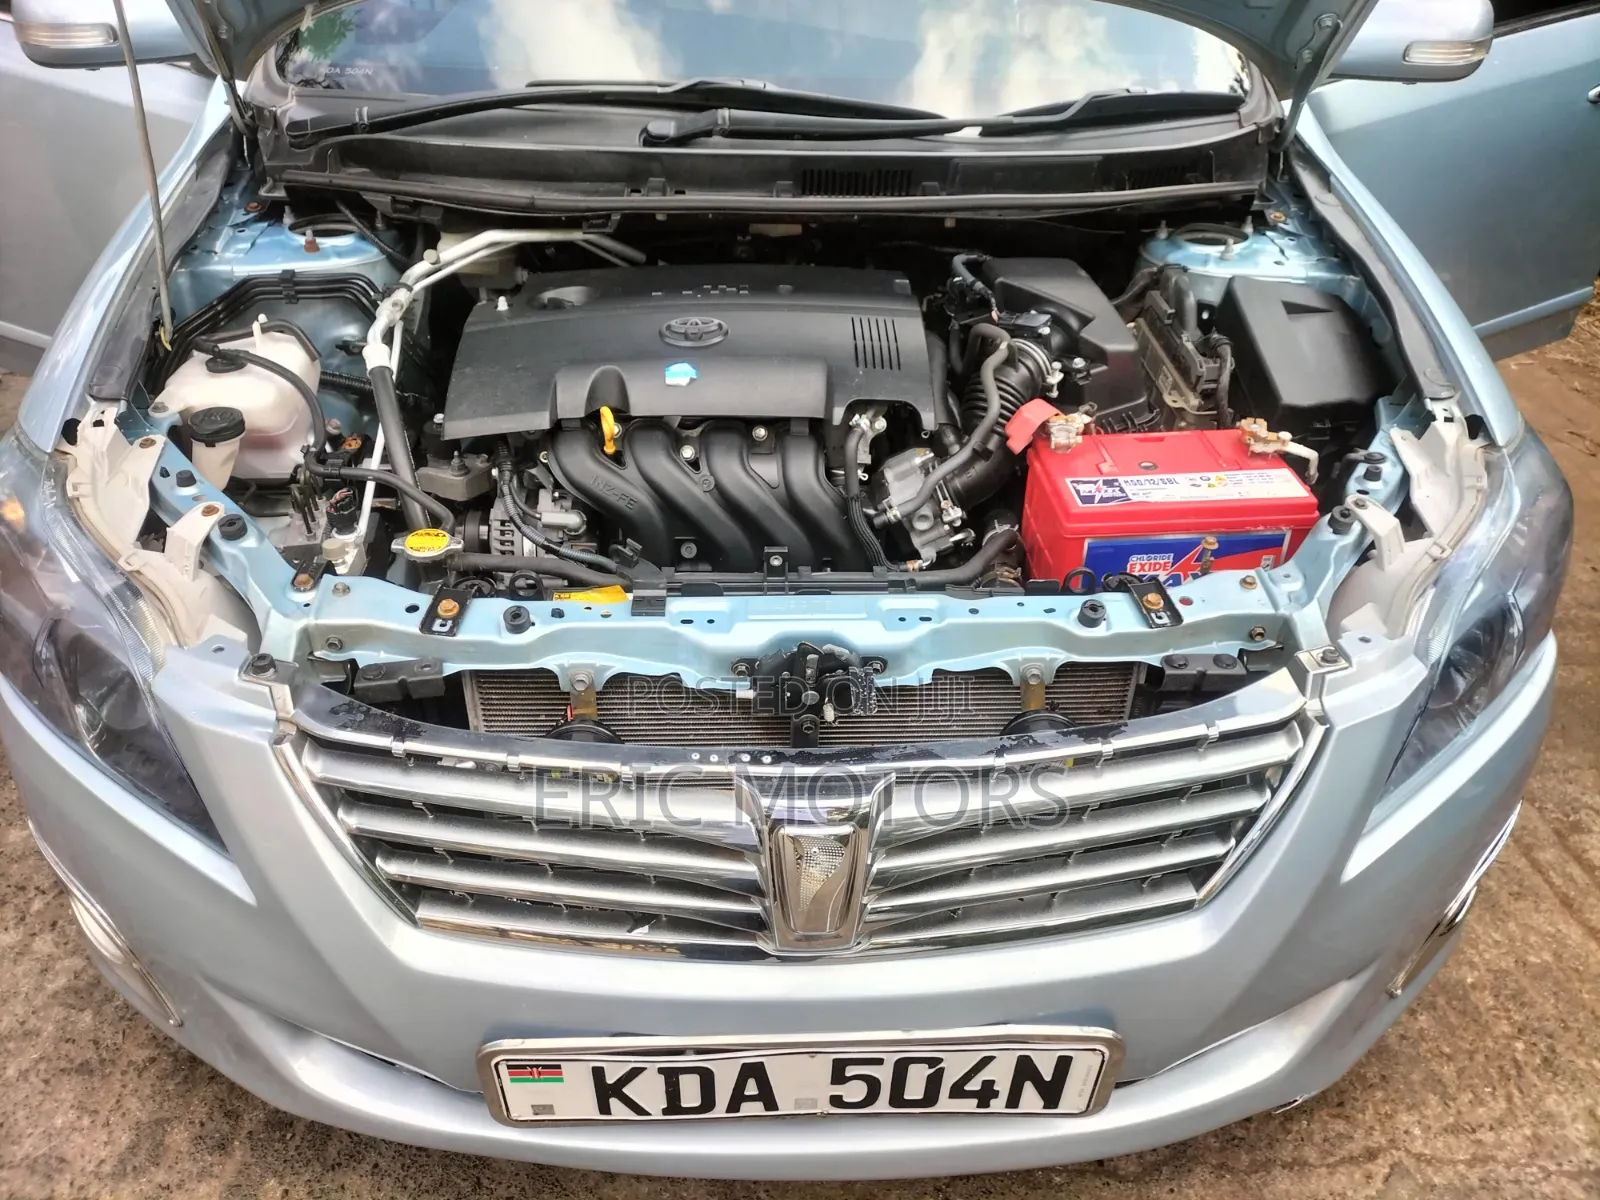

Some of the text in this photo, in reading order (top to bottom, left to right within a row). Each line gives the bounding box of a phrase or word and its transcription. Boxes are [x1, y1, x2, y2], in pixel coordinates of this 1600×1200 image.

[1130, 554, 1173, 562] CHLORIDE
[1128, 561, 1171, 573] EXIDE
[591, 1060, 780, 1116] KDA
[829, 1054, 1074, 1110] 504N
